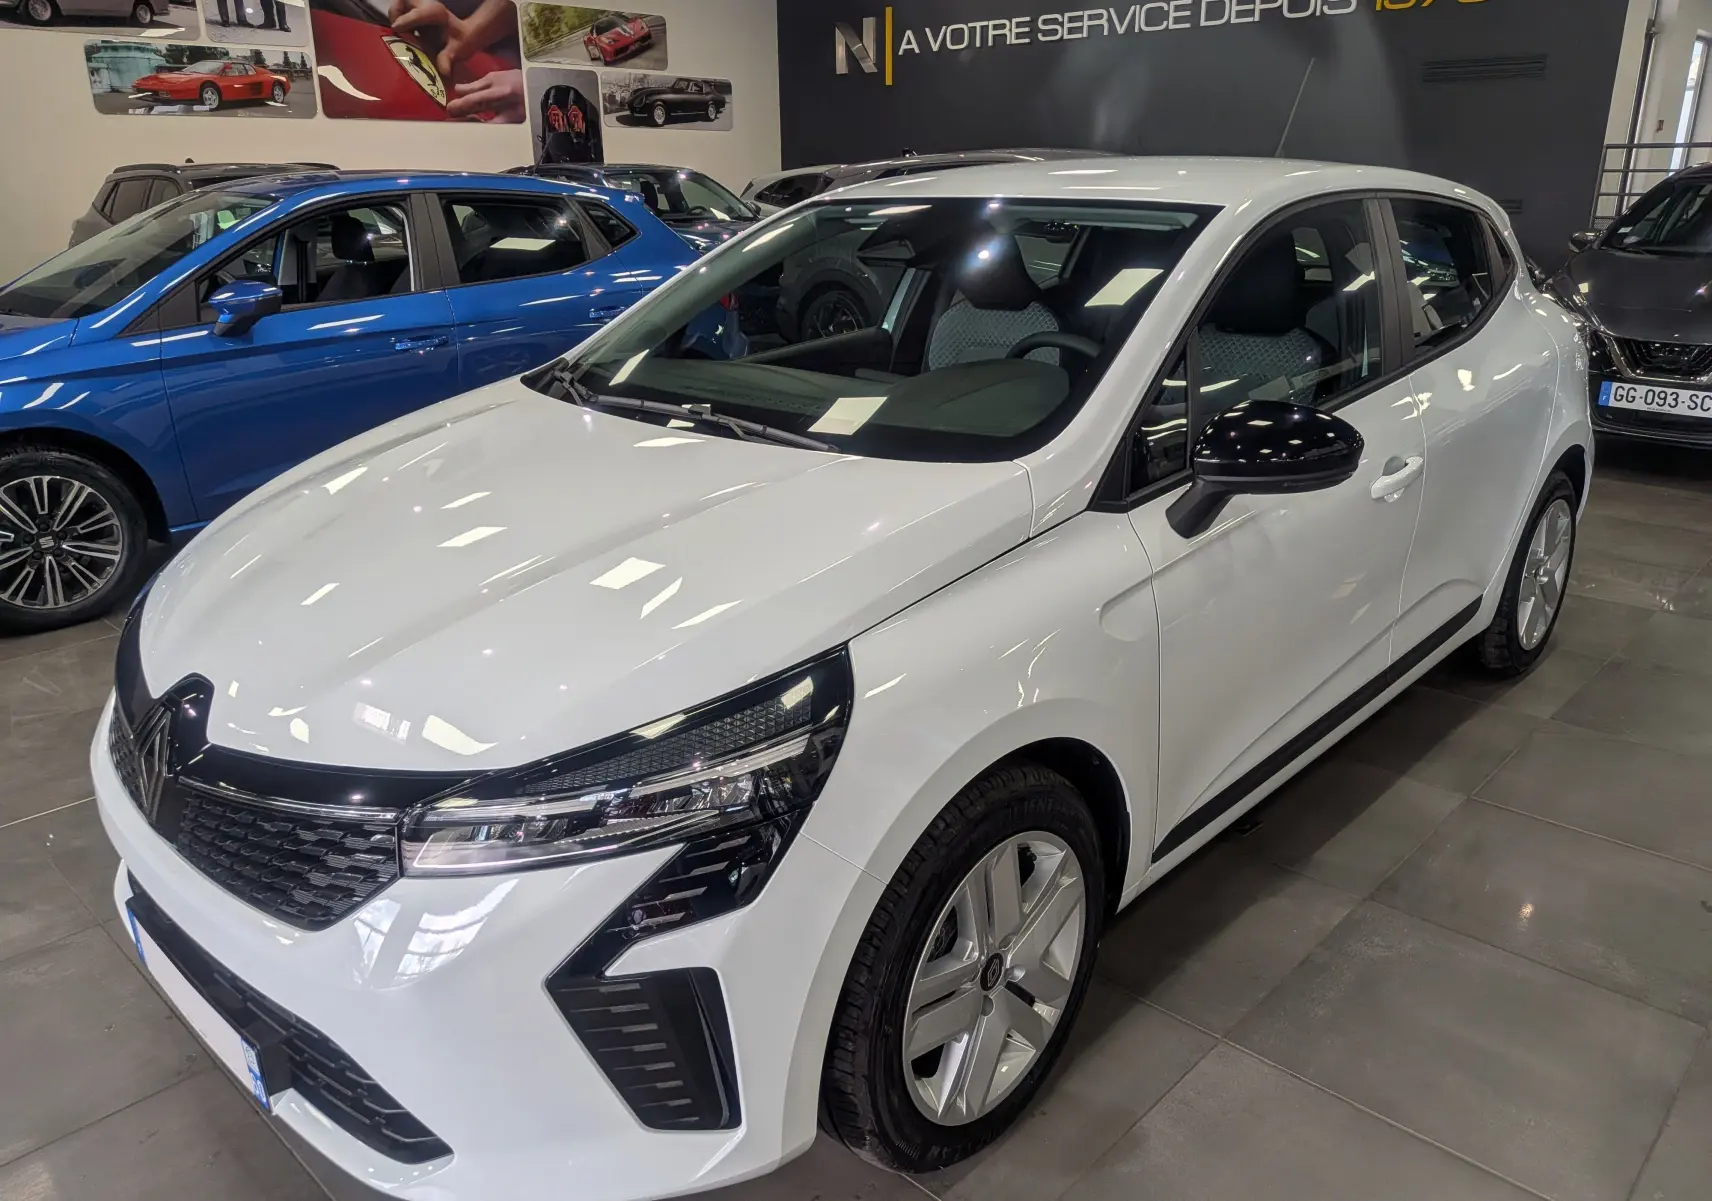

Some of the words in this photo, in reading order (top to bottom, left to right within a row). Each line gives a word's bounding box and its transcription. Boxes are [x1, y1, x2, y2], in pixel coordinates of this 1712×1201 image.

[835, 17, 877, 74] N
[898, 30, 920, 56] A
[925, 17, 1031, 52] VOTRE
[1038, 0, 1191, 41] SERVICE
